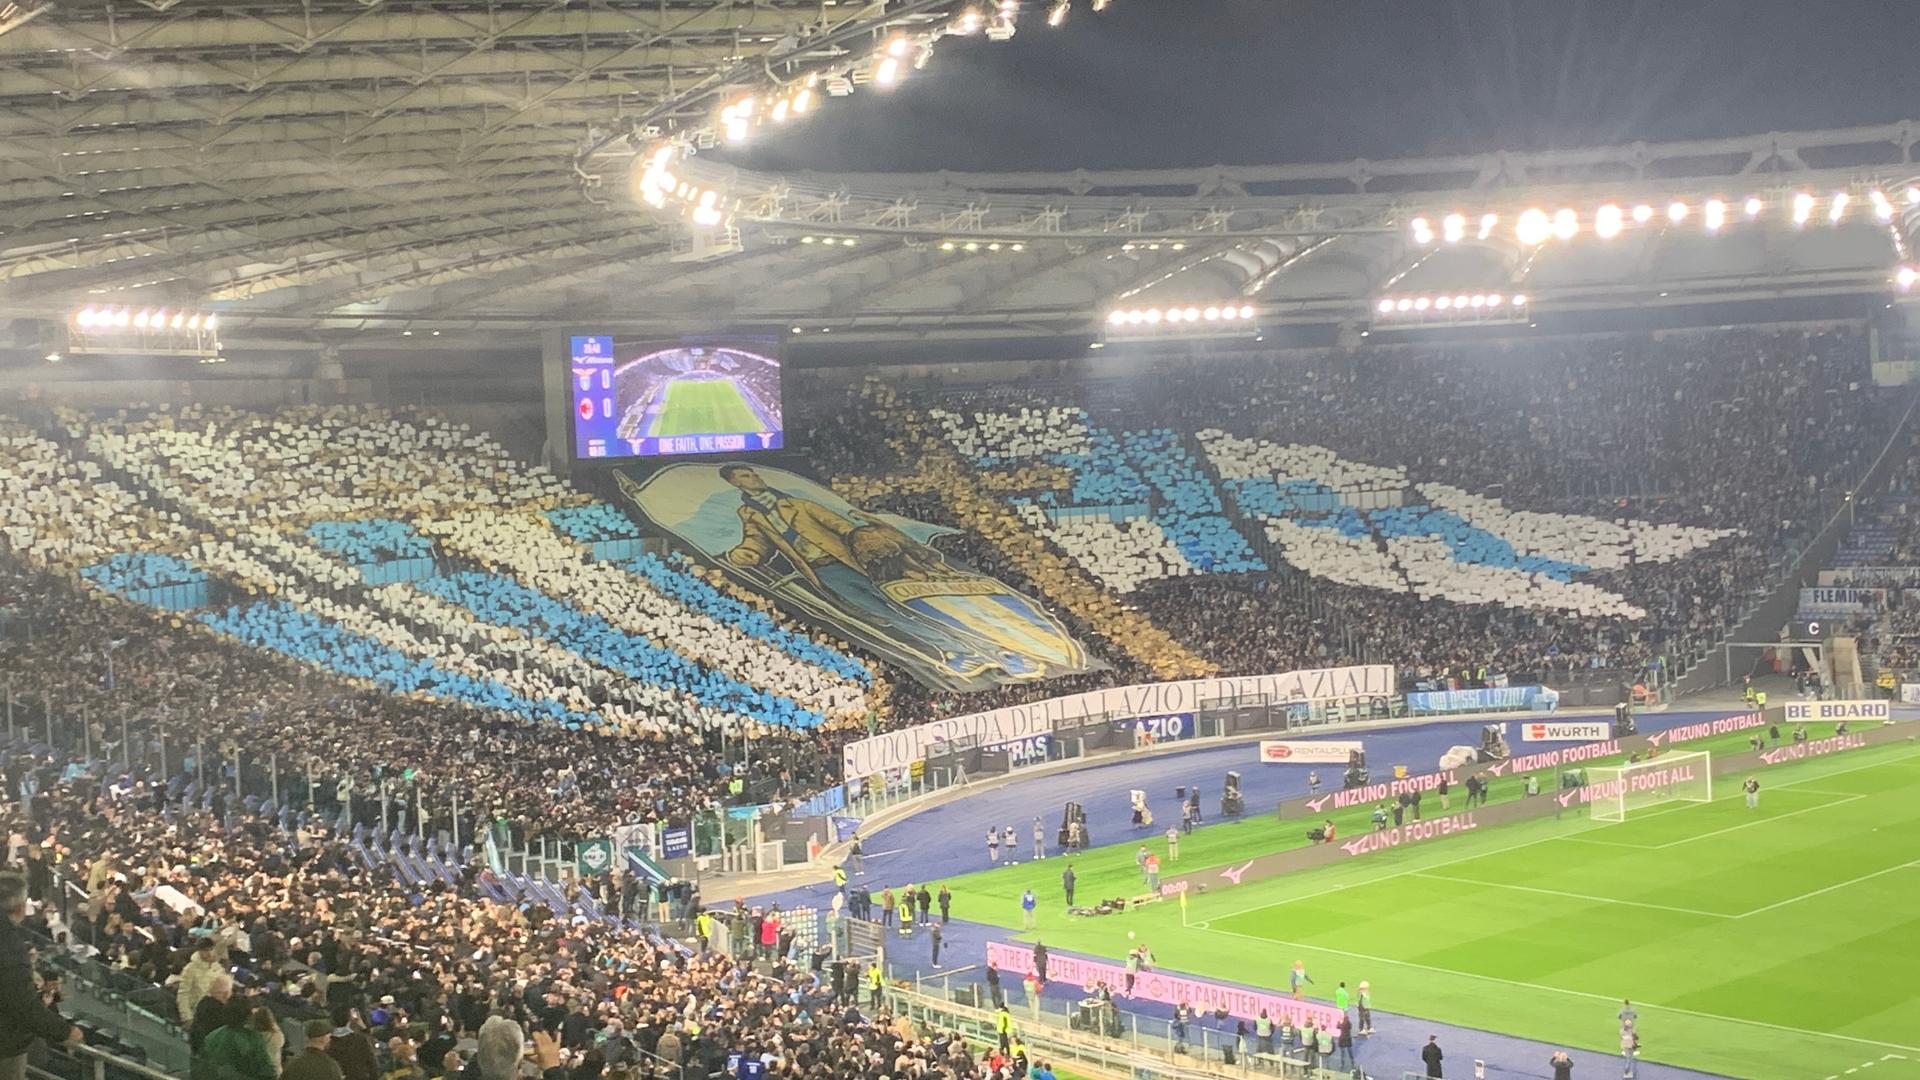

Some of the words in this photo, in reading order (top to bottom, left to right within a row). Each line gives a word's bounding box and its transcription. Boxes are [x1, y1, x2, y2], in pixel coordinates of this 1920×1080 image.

[1808, 622, 1820, 635] C
[1787, 704, 1812, 719] BE
[1820, 703, 1888, 718] BOARD
[1668, 723, 1711, 743] MIZUNO
[1712, 711, 1766, 735] FOOTBALL
[1512, 750, 1559, 774] MIZUNO
[1562, 739, 1622, 764] FOOTBALL
[1808, 732, 1866, 756] FOOTBALL
[1334, 783, 1388, 809] MIZUNO
[1391, 770, 1459, 797] FOOTBALL
[1579, 780, 1628, 804] MIZUNO
[1405, 812, 1477, 843] FOOTBALL
[1003, 949, 1025, 969] TRE
[1169, 980, 1191, 1001] TRE
[1195, 986, 1261, 1015] CARATTERI
